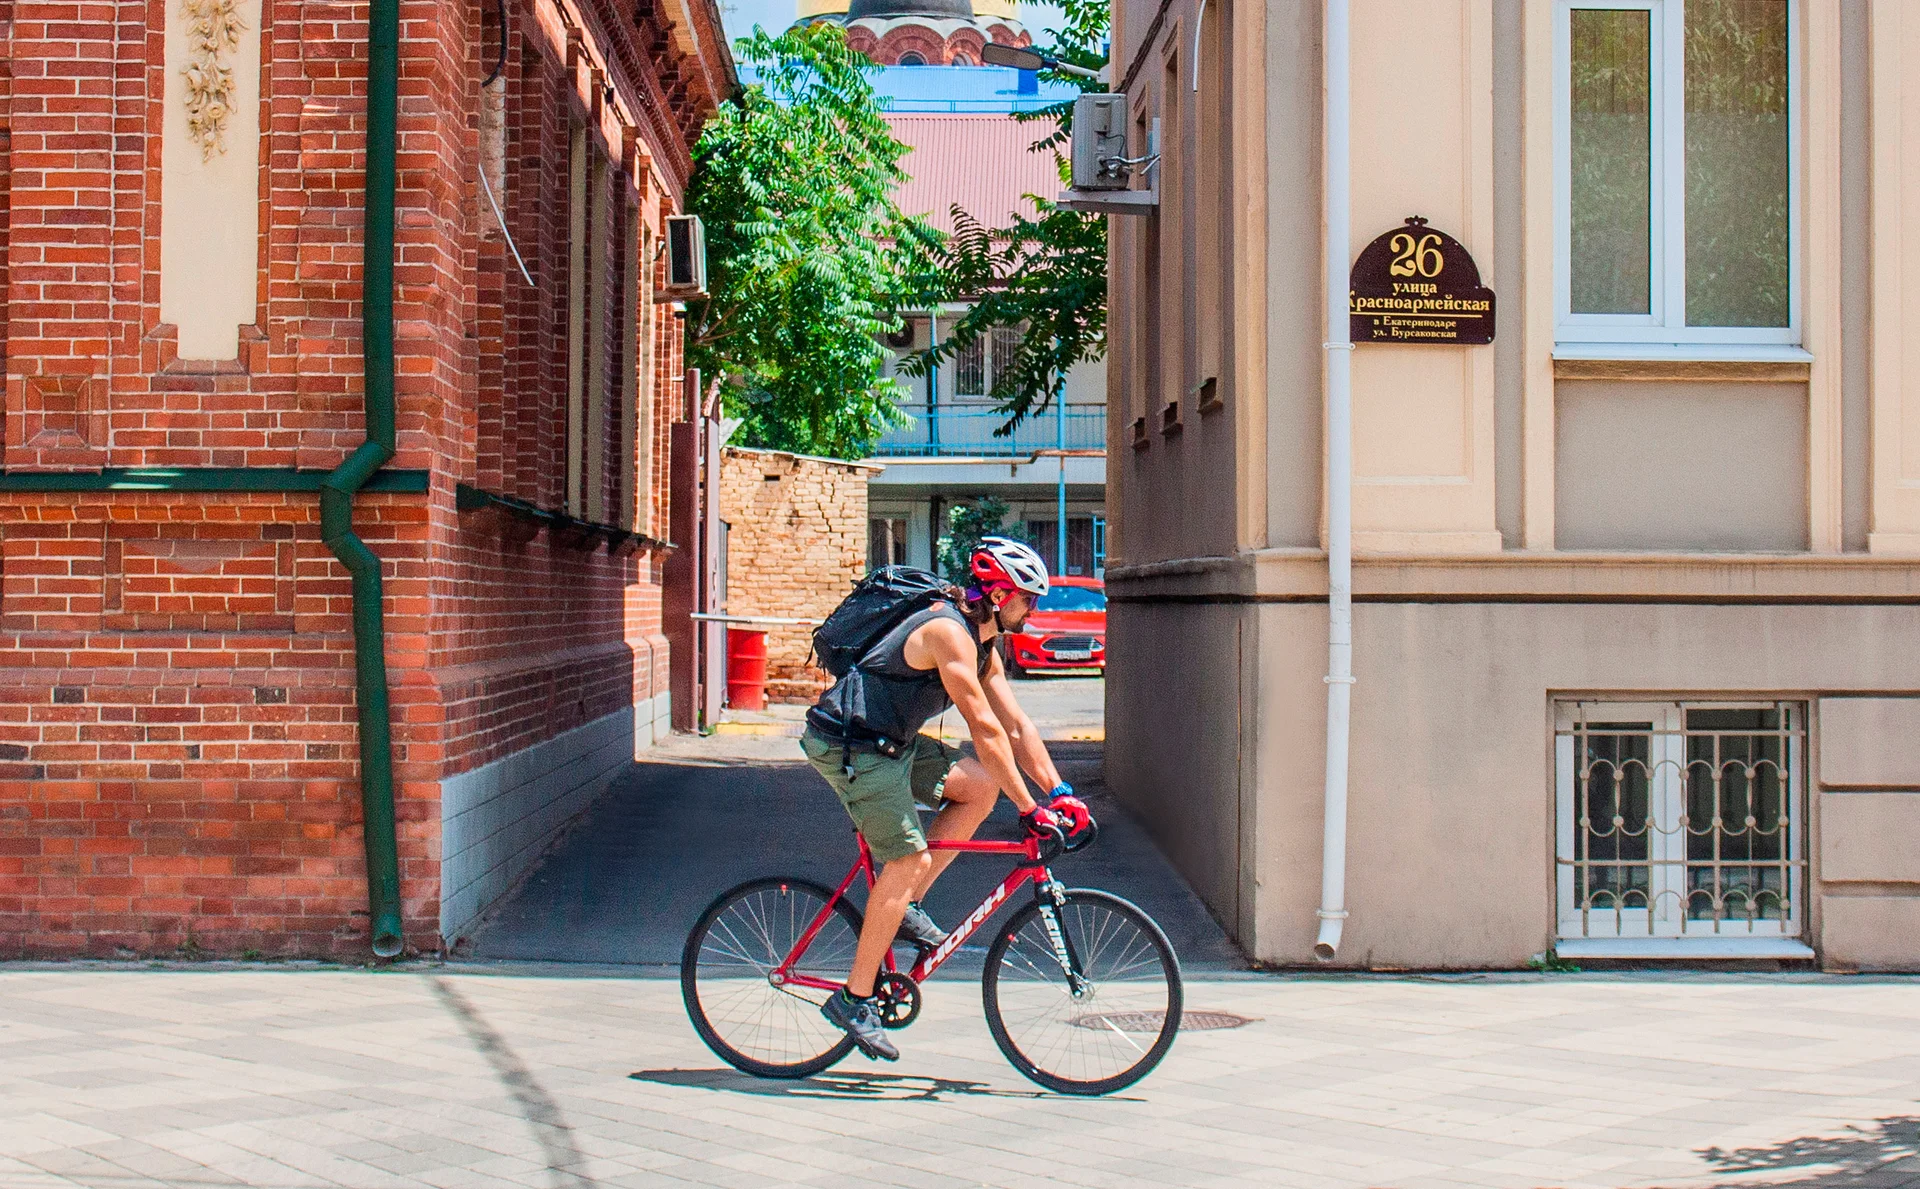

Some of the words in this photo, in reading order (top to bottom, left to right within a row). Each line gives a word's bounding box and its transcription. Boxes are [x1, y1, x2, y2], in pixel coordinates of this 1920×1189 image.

[1390, 233, 1444, 278] 26
[1392, 283, 1437, 296] улица
[1373, 329, 1387, 338] ул.
[1391, 327, 1457, 339] Бурсаковская
[1383, 316, 1457, 328] Екатеринодаре
[923, 882, 1005, 975] HORH
[1039, 904, 1071, 968] KEIRIN
